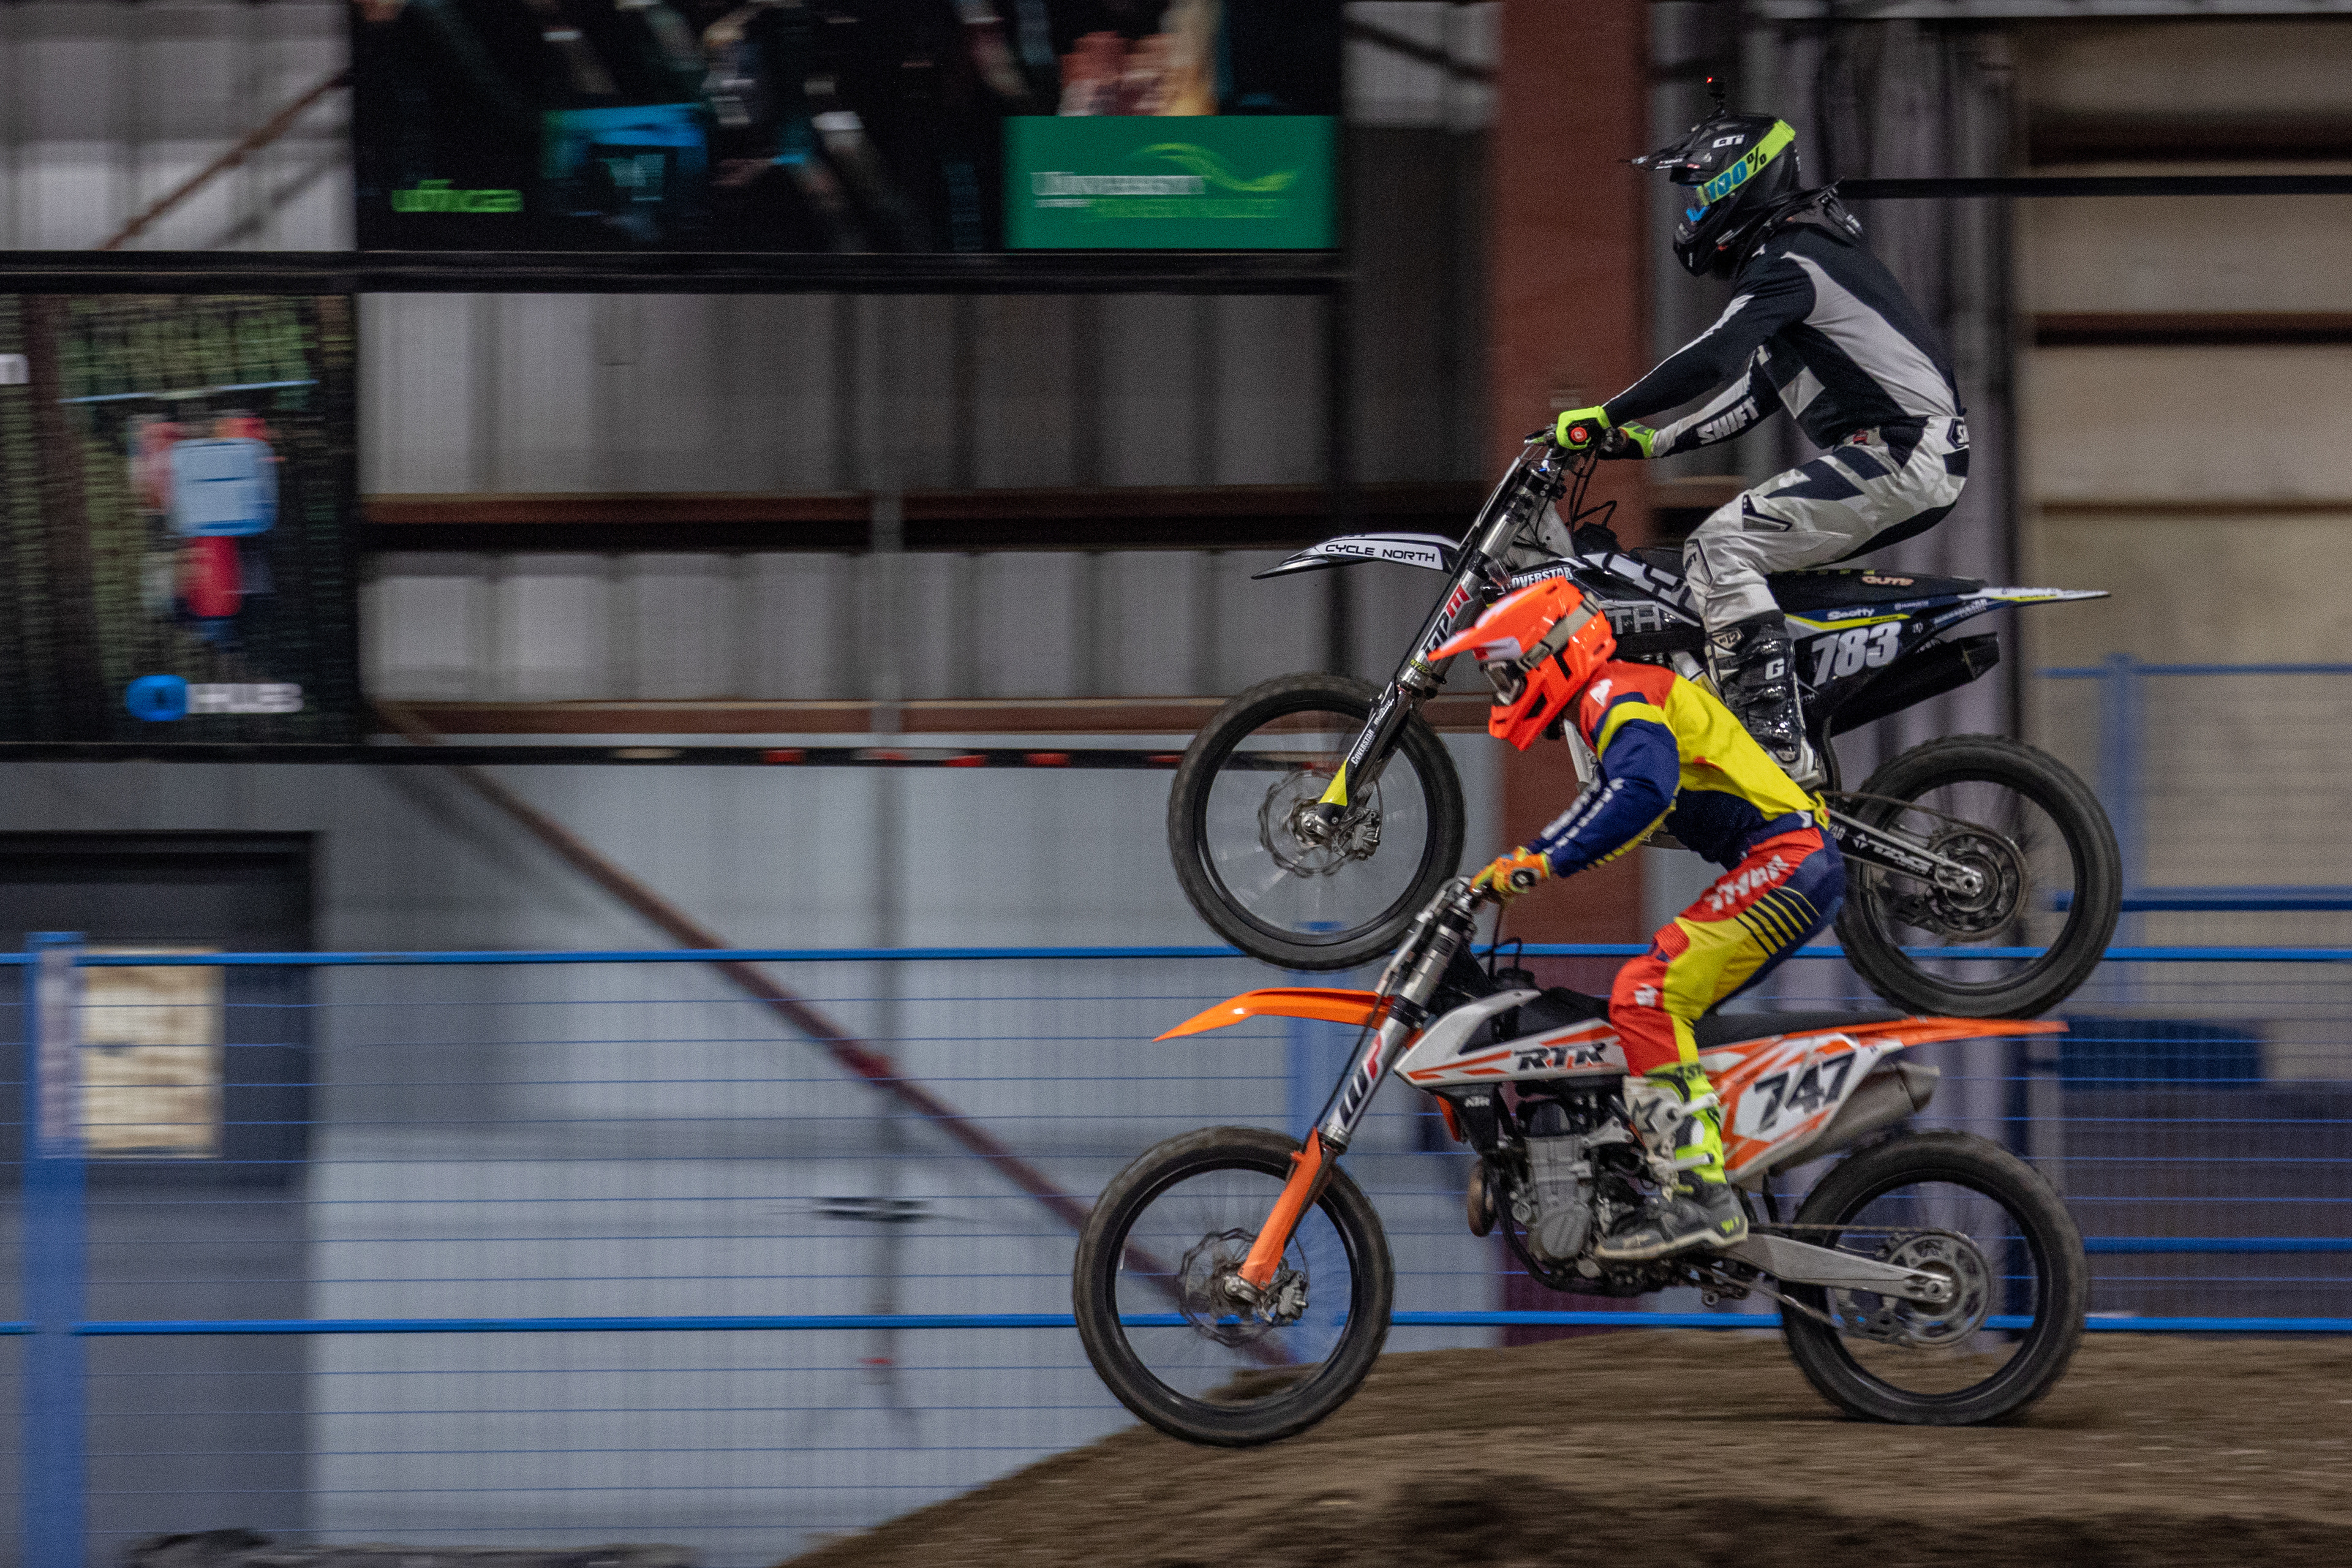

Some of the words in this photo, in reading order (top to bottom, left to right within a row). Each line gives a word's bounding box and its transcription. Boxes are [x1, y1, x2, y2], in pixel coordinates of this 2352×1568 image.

[1705, 145, 1768, 200] 100%
[1696, 395, 1760, 446] SHIFT
[1325, 544, 1375, 556] CYCLE
[1382, 549, 1436, 562] NORTH
[1510, 566, 1574, 589] OVERSTAR
[1765, 658, 1785, 680] G
[1811, 620, 1902, 687] 783
[1754, 1052, 1858, 1134] 747
